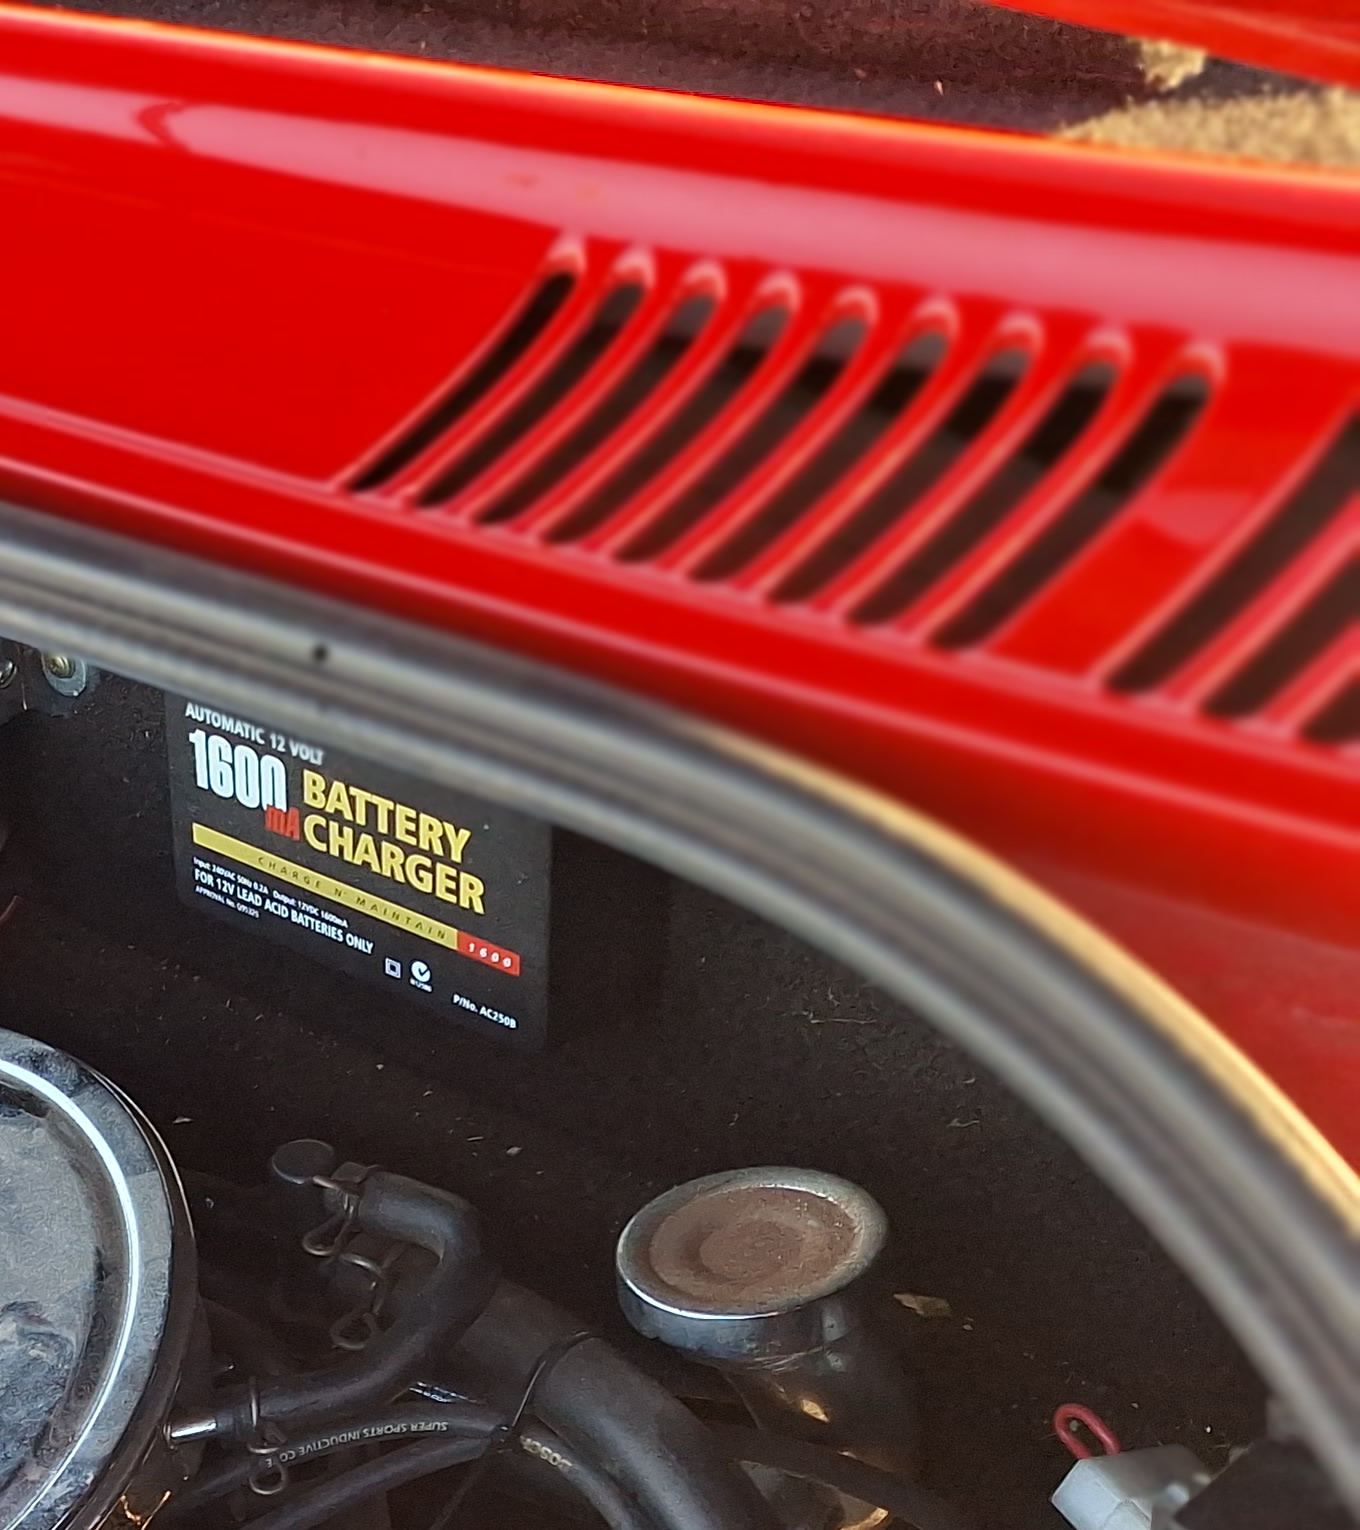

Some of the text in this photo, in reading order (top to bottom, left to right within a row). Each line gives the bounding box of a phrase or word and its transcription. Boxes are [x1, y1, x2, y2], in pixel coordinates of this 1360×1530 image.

[185, 702, 324, 766] AUTOMATIC 12 VOLT
[189, 728, 288, 813] 1600
[303, 768, 472, 864] BATTERY
[258, 856, 321, 889] CHARGE
[356, 896, 446, 940] MAINTAIN
[303, 814, 486, 915] CHARGER
[194, 868, 374, 955] FOR 12V LEAD ACID BATTERIES ONLY
[468, 942, 512, 968] 1600
[479, 1006, 518, 1029] AC250B
[265, 1421, 449, 1469] SUPER SPORTS INDUCTIVE COE
